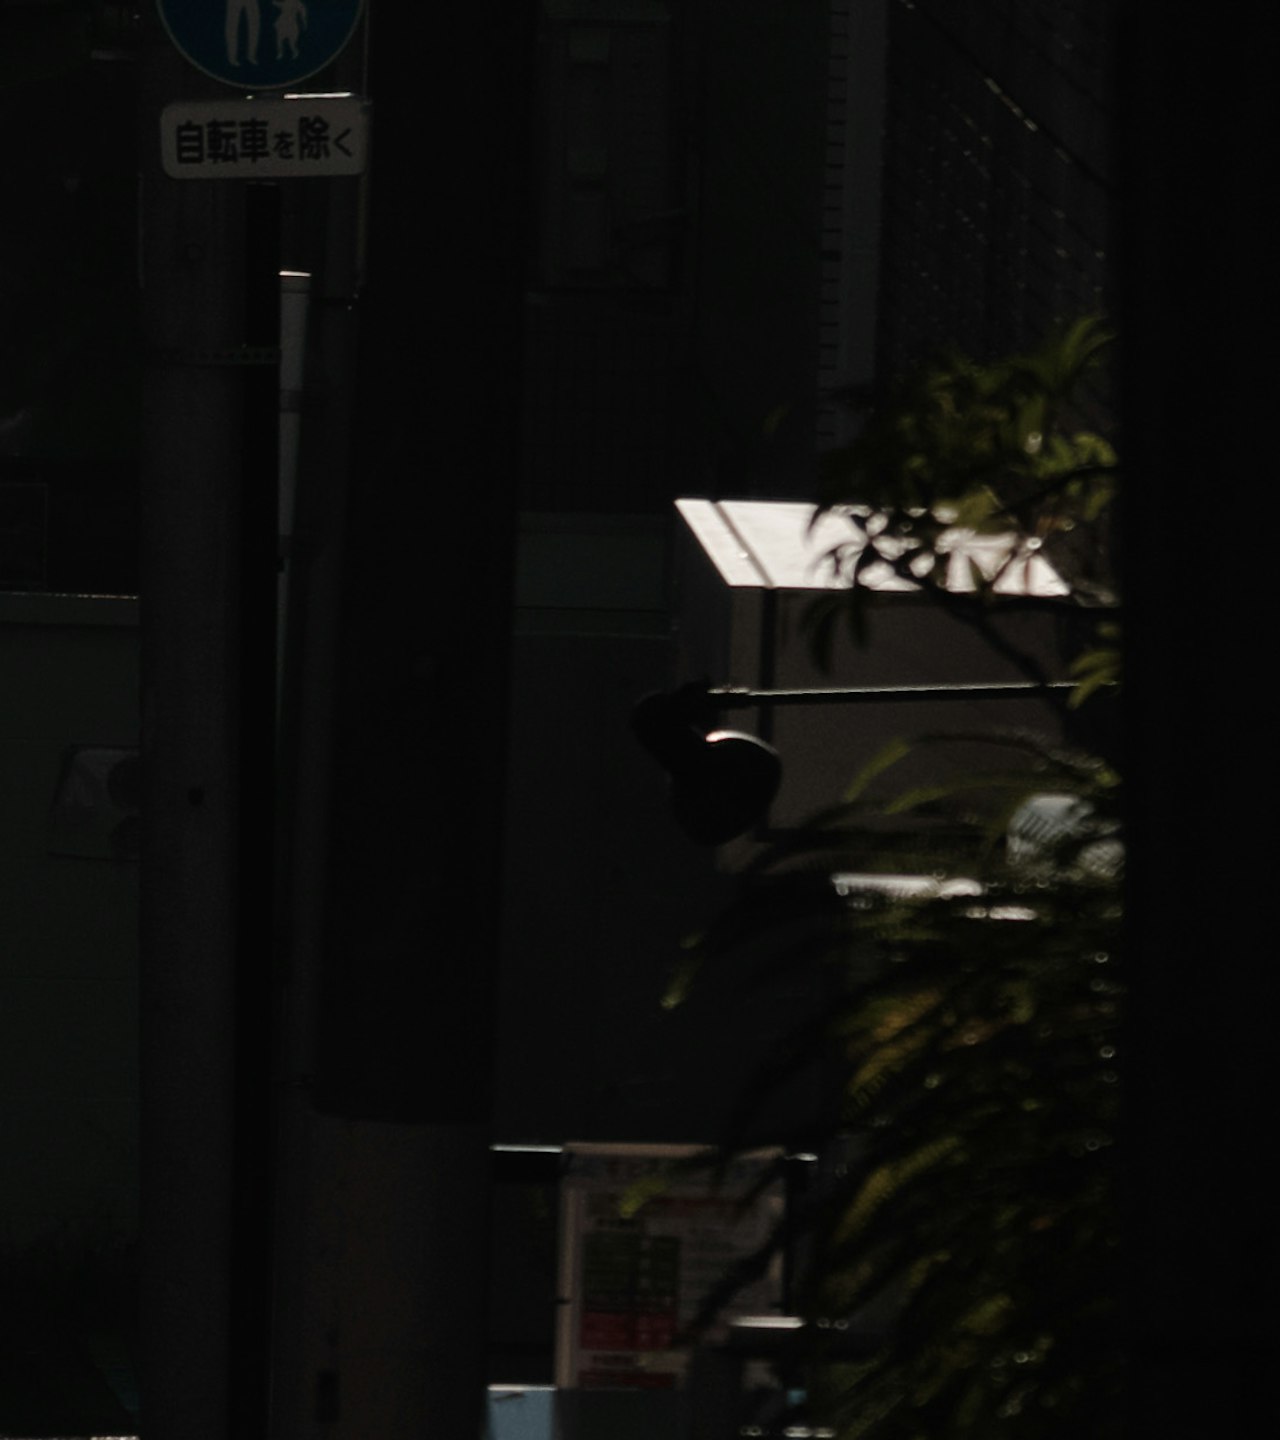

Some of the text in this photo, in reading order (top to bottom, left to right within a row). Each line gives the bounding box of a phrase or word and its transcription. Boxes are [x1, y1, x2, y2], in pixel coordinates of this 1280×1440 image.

[176, 115, 352, 164] 自転車を除く
